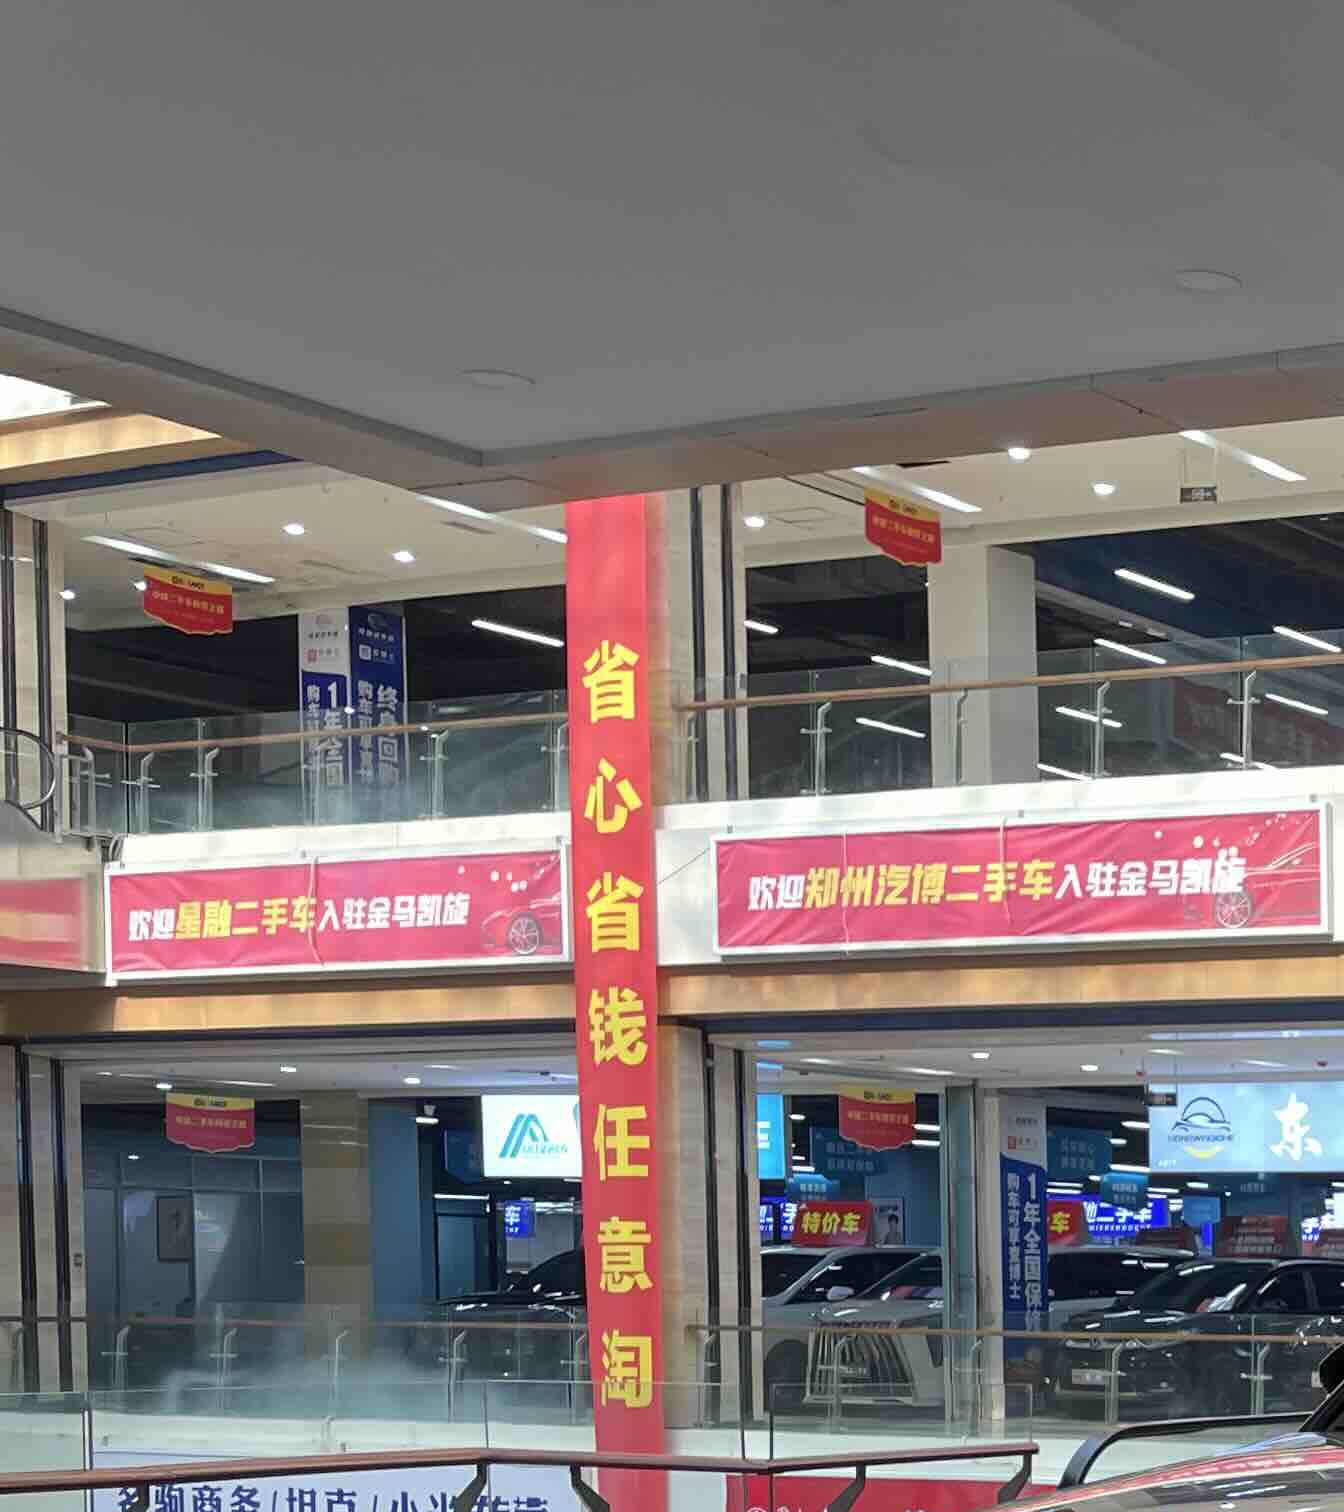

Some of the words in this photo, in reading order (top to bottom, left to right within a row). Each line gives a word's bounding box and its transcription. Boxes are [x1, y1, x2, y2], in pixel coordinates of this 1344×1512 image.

[747, 848, 1250, 912] 欢迎郑州汽博二手车入驻金马凯旋
[581, 639, 656, 1411] 省心省钱任意淘
[801, 1211, 862, 1236] 特价车
